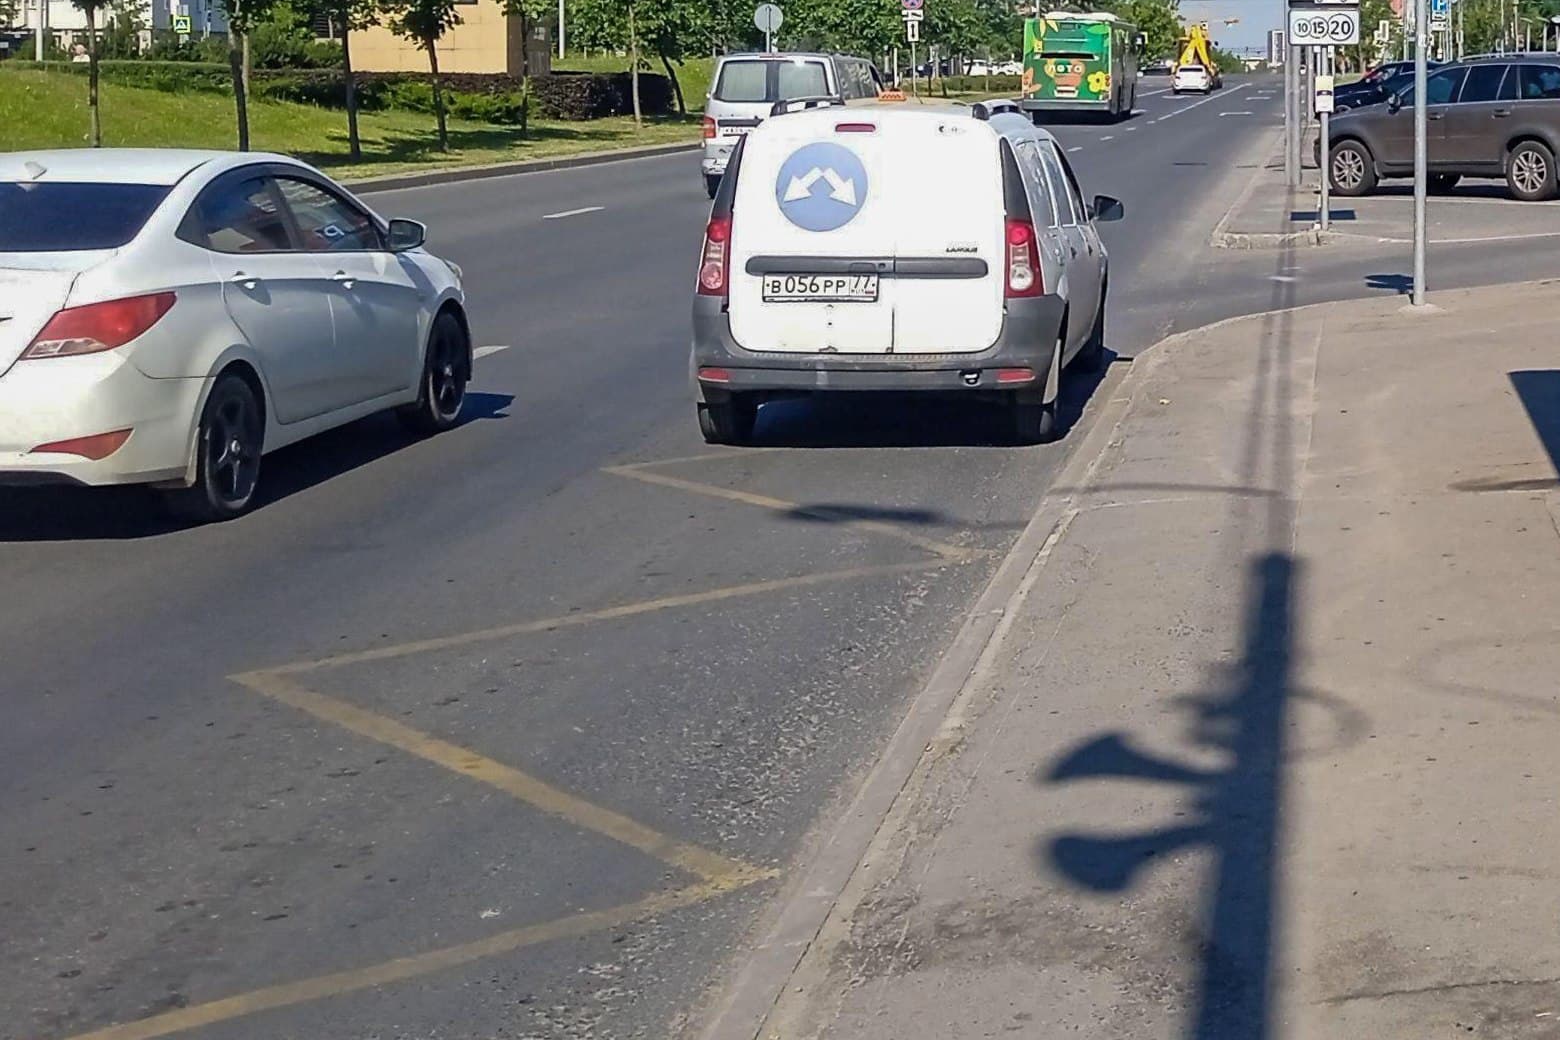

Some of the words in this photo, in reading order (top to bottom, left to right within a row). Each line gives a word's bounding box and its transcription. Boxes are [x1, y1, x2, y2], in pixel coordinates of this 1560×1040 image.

[1297, 22, 1309, 33] 10
[1313, 21, 1326, 34] 15
[1331, 20, 1351, 35] 20
